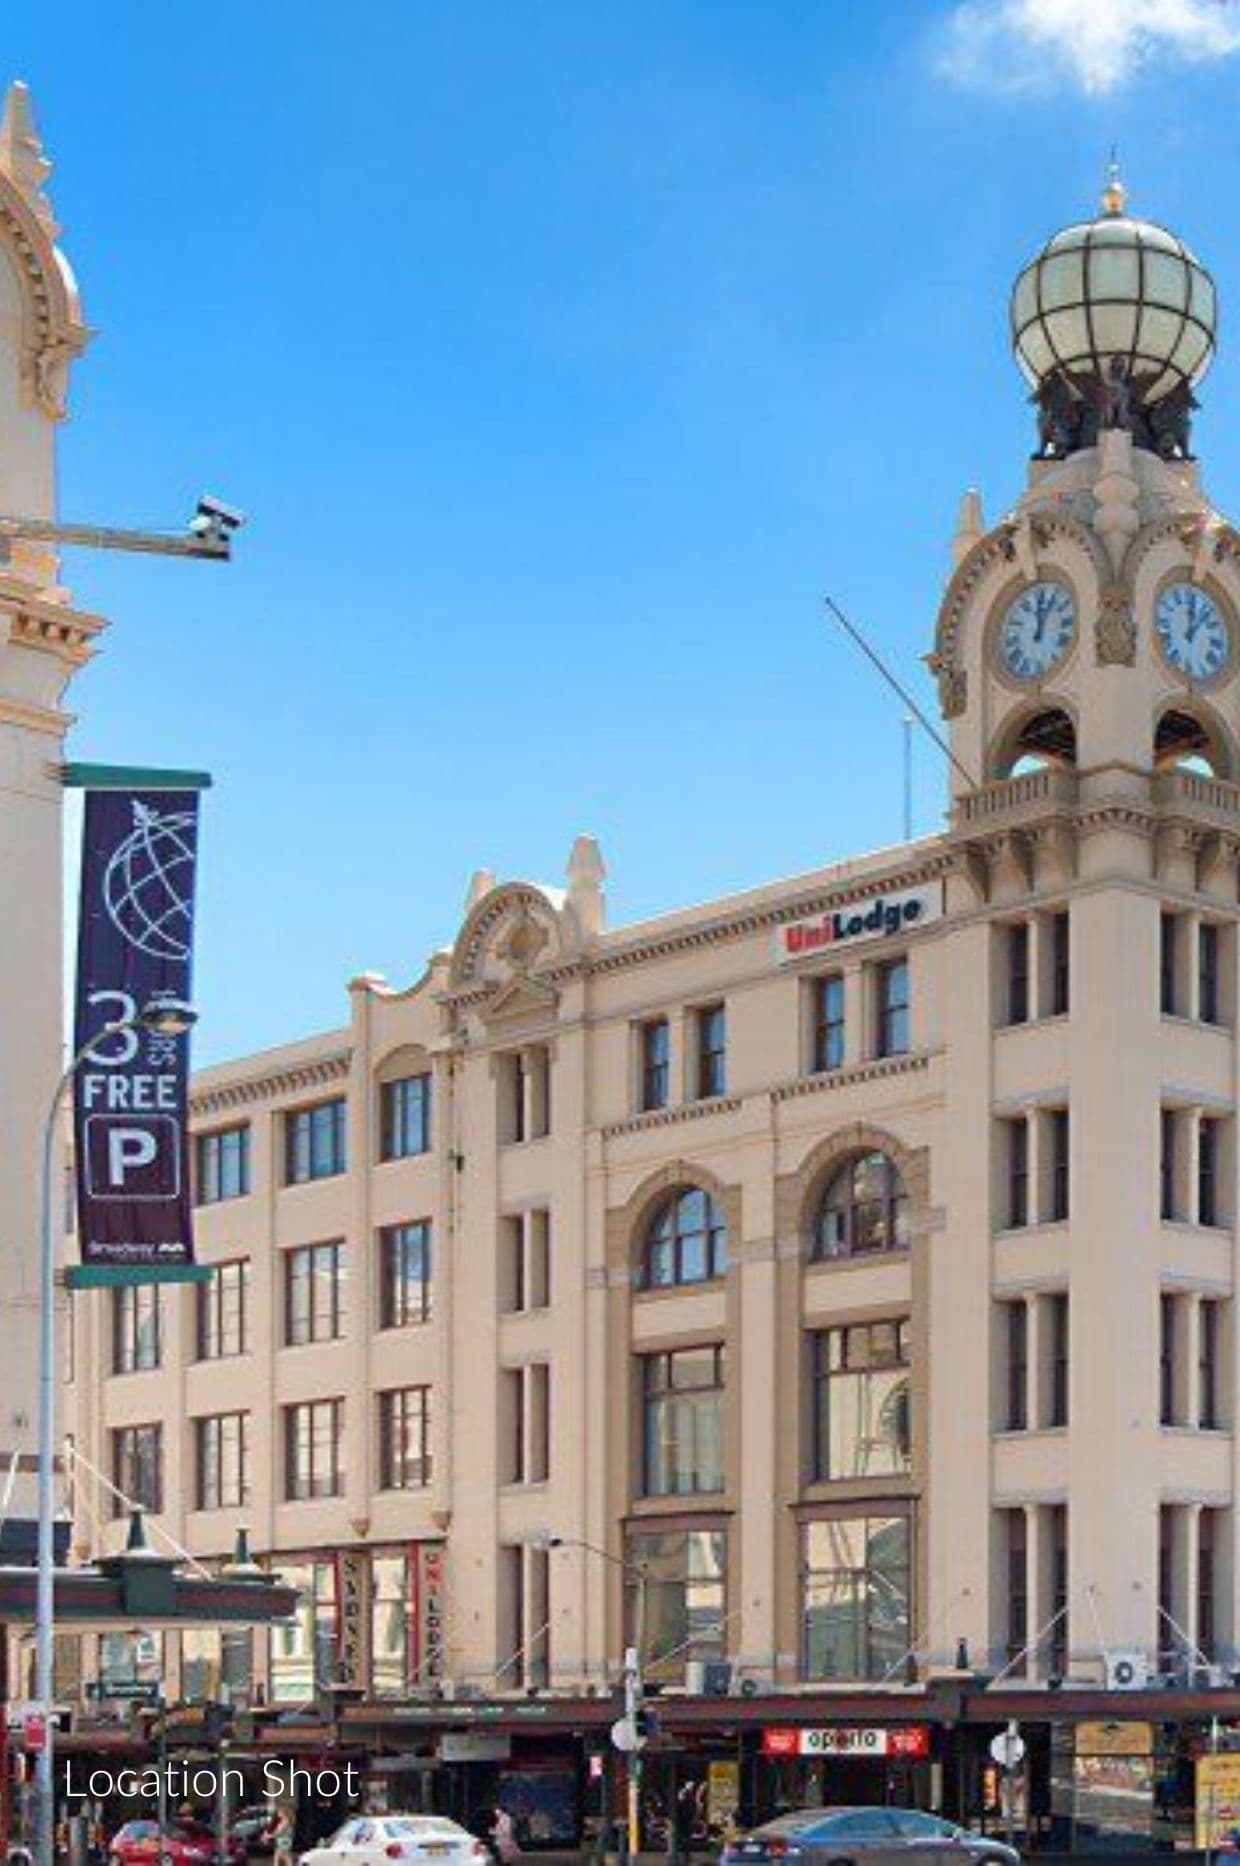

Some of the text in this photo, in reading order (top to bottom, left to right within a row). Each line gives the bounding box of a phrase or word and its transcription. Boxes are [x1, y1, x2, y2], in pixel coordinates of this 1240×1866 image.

[787, 898, 921, 953] UniLodge
[87, 990, 138, 1066] 3
[84, 1074, 177, 1108] FREE
[109, 1128, 158, 1186] P
[808, 1730, 877, 1749] oporto
